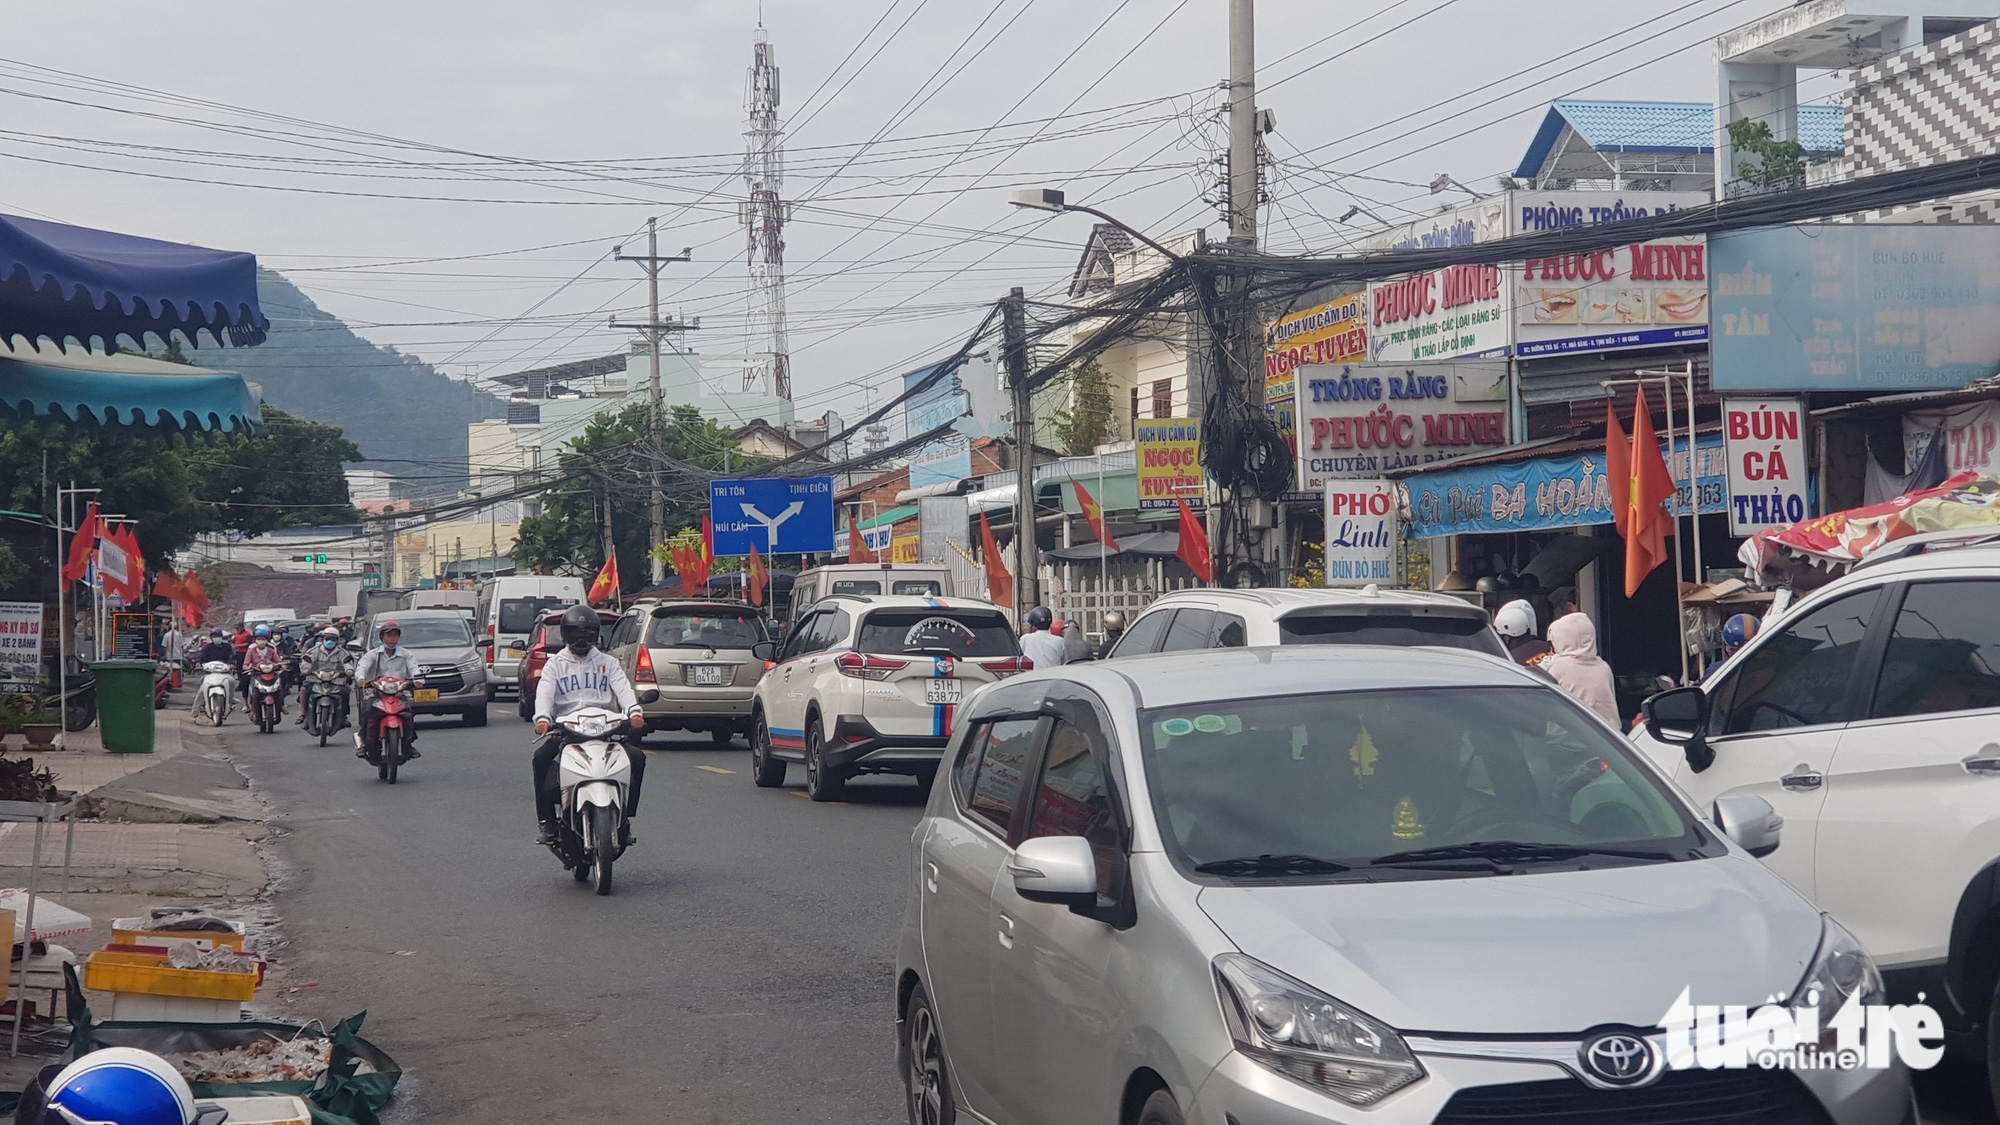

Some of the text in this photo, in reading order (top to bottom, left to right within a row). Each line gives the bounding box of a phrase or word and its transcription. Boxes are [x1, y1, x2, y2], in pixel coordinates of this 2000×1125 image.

[1522, 201, 1583, 230] PHÒNG
[1630, 244, 1705, 280] MINH
[1441, 263, 1499, 310] MINH
[1278, 319, 1301, 342] DỊCH
[1302, 316, 1317, 334] VỤ
[1266, 344, 1311, 379] NGỌC
[1309, 366, 1448, 402] TRỒNG RĂNG
[1310, 403, 1414, 450] PHƯỚC
[1422, 412, 1505, 446] MINH
[1728, 404, 1798, 440] BÚN
[1138, 426, 1156, 446] DỊCH
[1157, 426, 1167, 446] VỤ
[1143, 447, 1194, 471] NGỌC
[1310, 453, 1377, 473] CHUYÊN
[1383, 455, 1416, 470] LÀM
[1743, 445, 1789, 481] CÁ
[714, 485, 745, 497] TRI TÔN
[810, 481, 829, 493] BIÊN
[1332, 485, 1391, 516] PHỞ
[1446, 483, 1487, 526] Phê
[1491, 481, 1526, 523] BA
[1536, 456, 1613, 519] HOẰN
[1733, 486, 1804, 524] THẢO
[715, 521, 729, 532] NÚI
[1332, 519, 1391, 548] Linh
[1332, 554, 1391, 579] BÚN BÒ HUẾ
[2, 636, 36, 648] XE 2 BÁNH
[556, 672, 609, 695] ITALIA
[927, 691, 960, 702] 638.77
[934, 680, 954, 691] 51H
